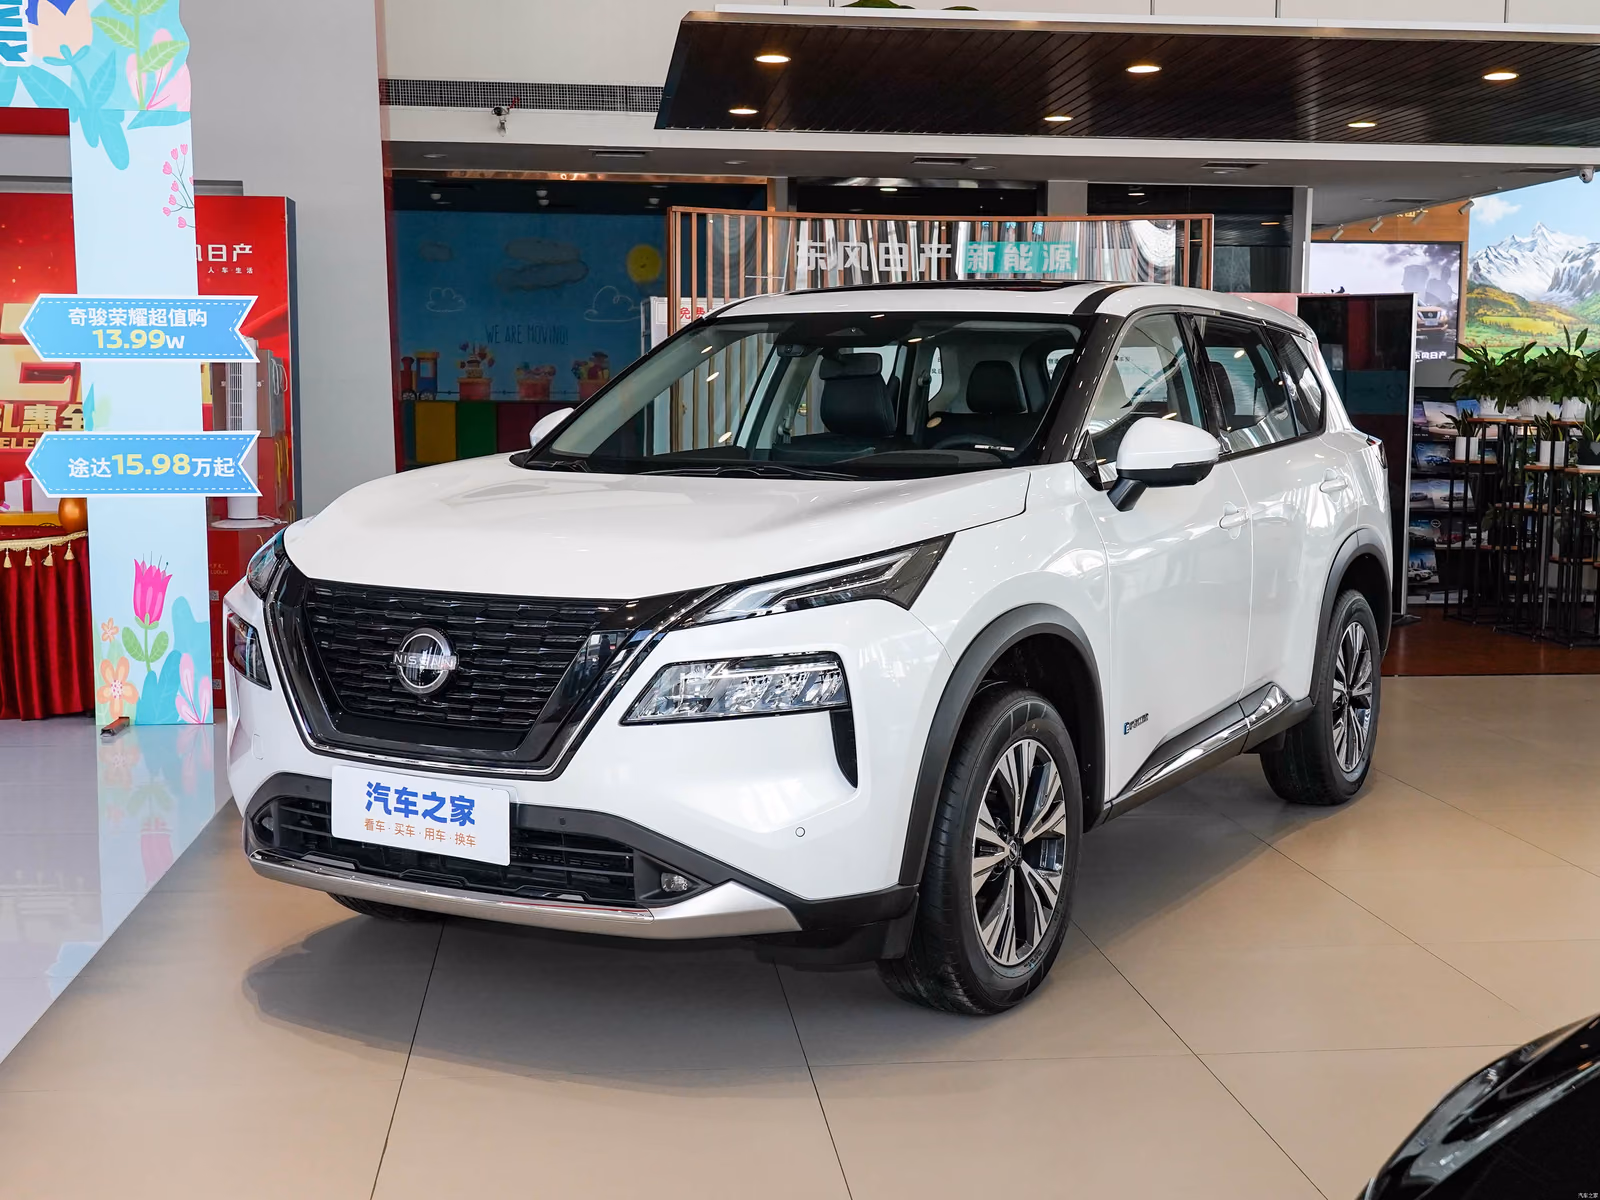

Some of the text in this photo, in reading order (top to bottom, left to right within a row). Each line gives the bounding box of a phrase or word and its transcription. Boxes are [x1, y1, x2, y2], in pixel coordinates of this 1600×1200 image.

[796, 240, 1073, 272] 东风日产 新能源
[68, 307, 207, 327] 奇骏荣耀超值购
[485, 324, 500, 344] WE
[505, 324, 523, 344] ARE
[0, 437, 40, 449] ELE
[68, 453, 235, 478] 途达15.98万起
[365, 781, 475, 827] 汽车之家
